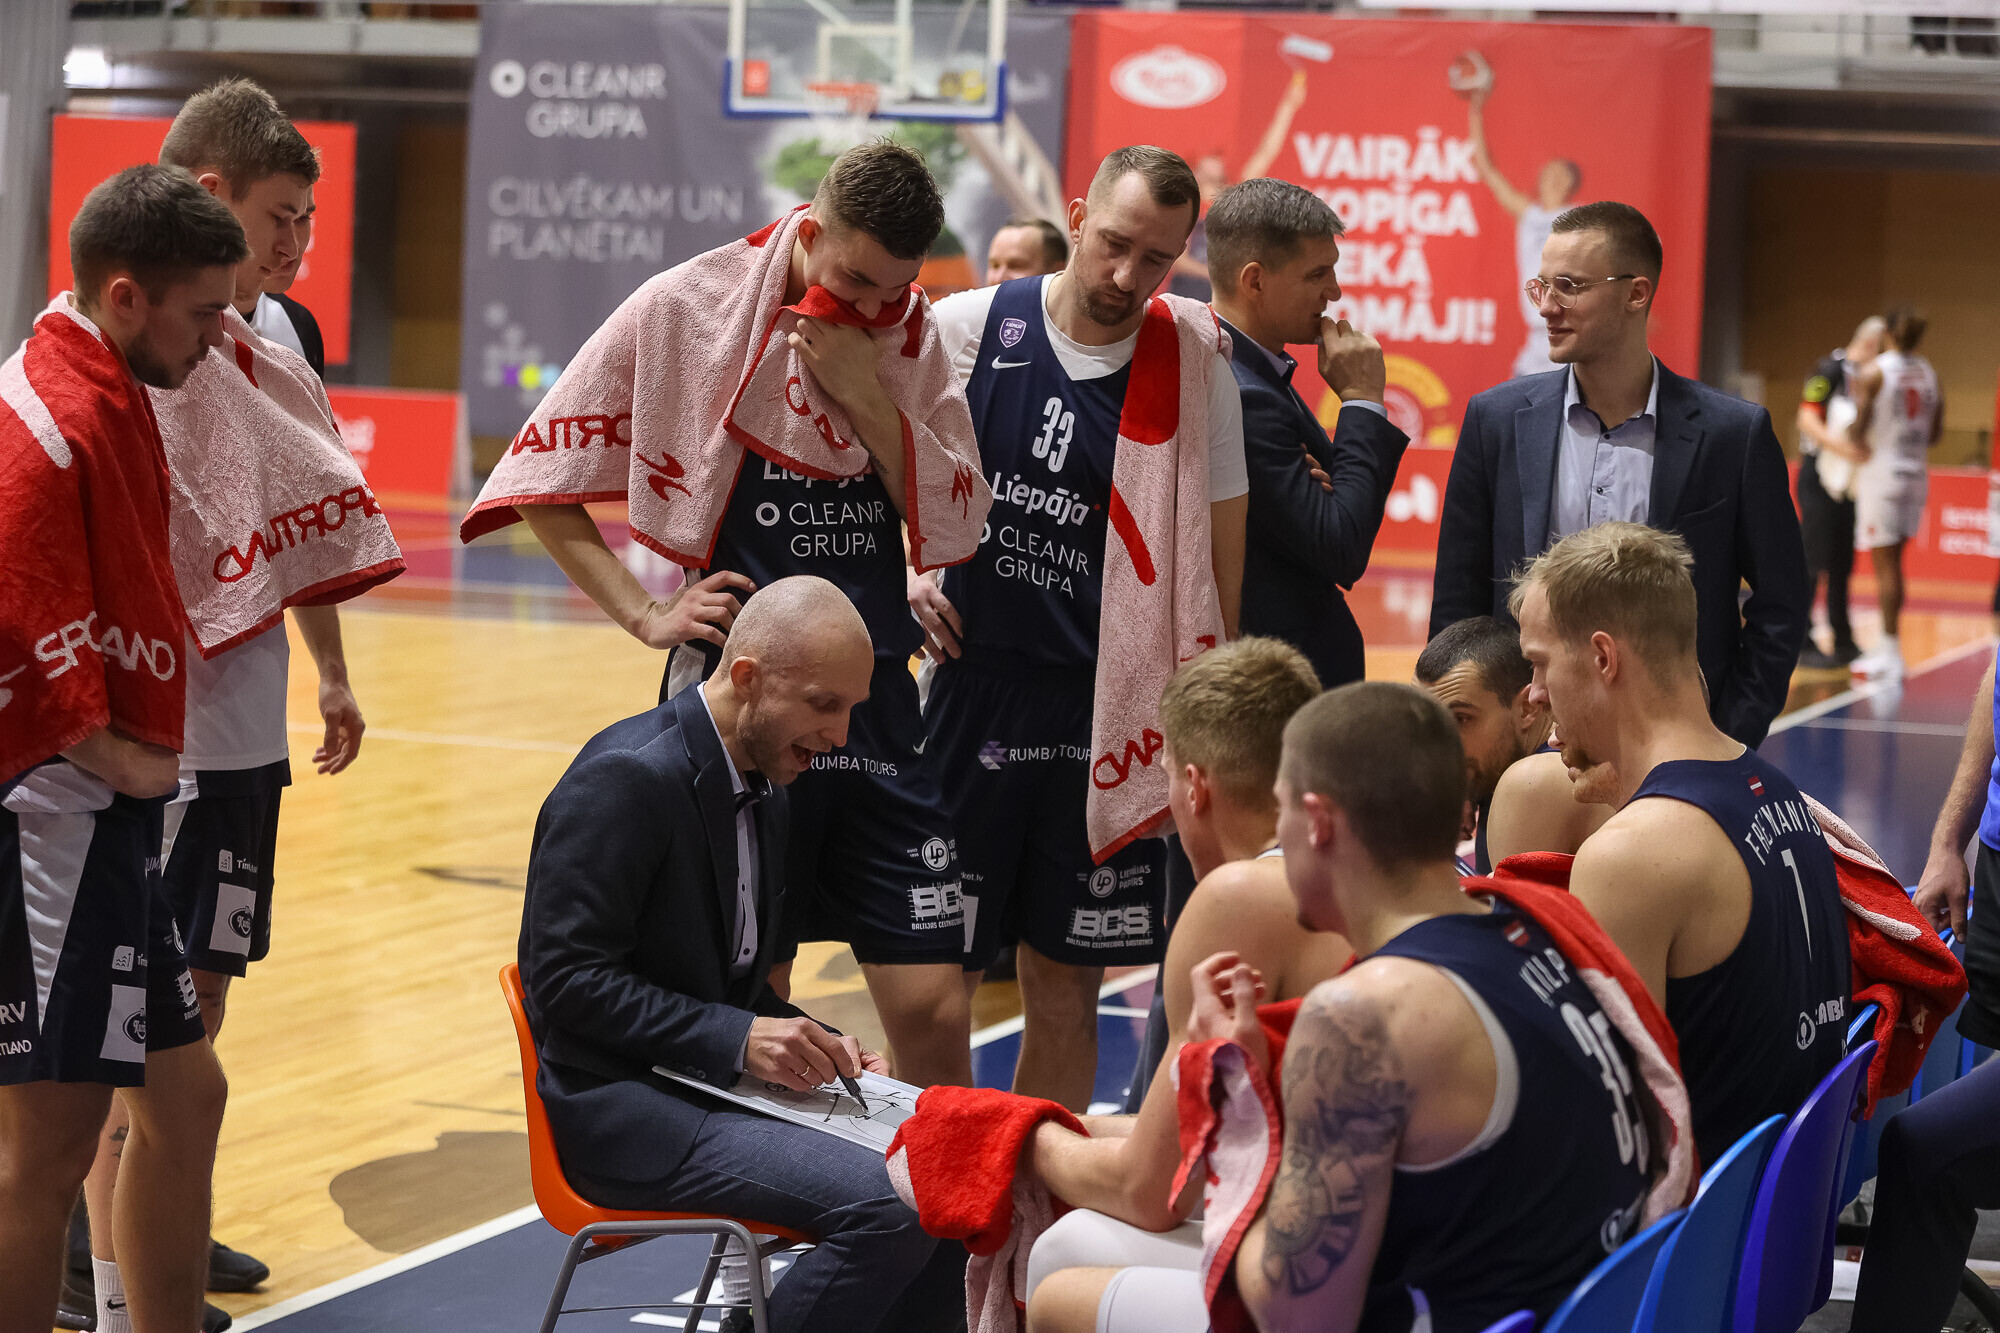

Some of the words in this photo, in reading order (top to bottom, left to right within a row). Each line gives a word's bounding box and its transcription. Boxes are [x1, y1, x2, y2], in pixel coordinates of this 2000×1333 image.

[527, 61, 668, 99] CLEANR
[525, 101, 648, 139] GRUPA
[1294, 126, 1482, 183] VAIRĀK
[488, 173, 675, 220] CILVĒKAM
[679, 182, 744, 223] UN
[1314, 181, 1480, 237] OPĪGA
[1334, 235, 1432, 289] EKĀ
[1323, 290, 1498, 345] OMĀJI!
[1031, 397, 1075, 473] 33
[789, 501, 886, 526] CLEANR
[992, 471, 1090, 526] Liepāja
[790, 532, 877, 557] GRUPA
[999, 525, 1089, 576] CLEANR
[995, 555, 1074, 599] GRUPA
[863, 758, 898, 776] TOURS
[1059, 745, 1092, 761] TOUR
[1745, 800, 1821, 866] FREMANIS
[908, 882, 964, 920] BC
[1072, 905, 1151, 937] BCS
[1781, 848, 1812, 962] 1
